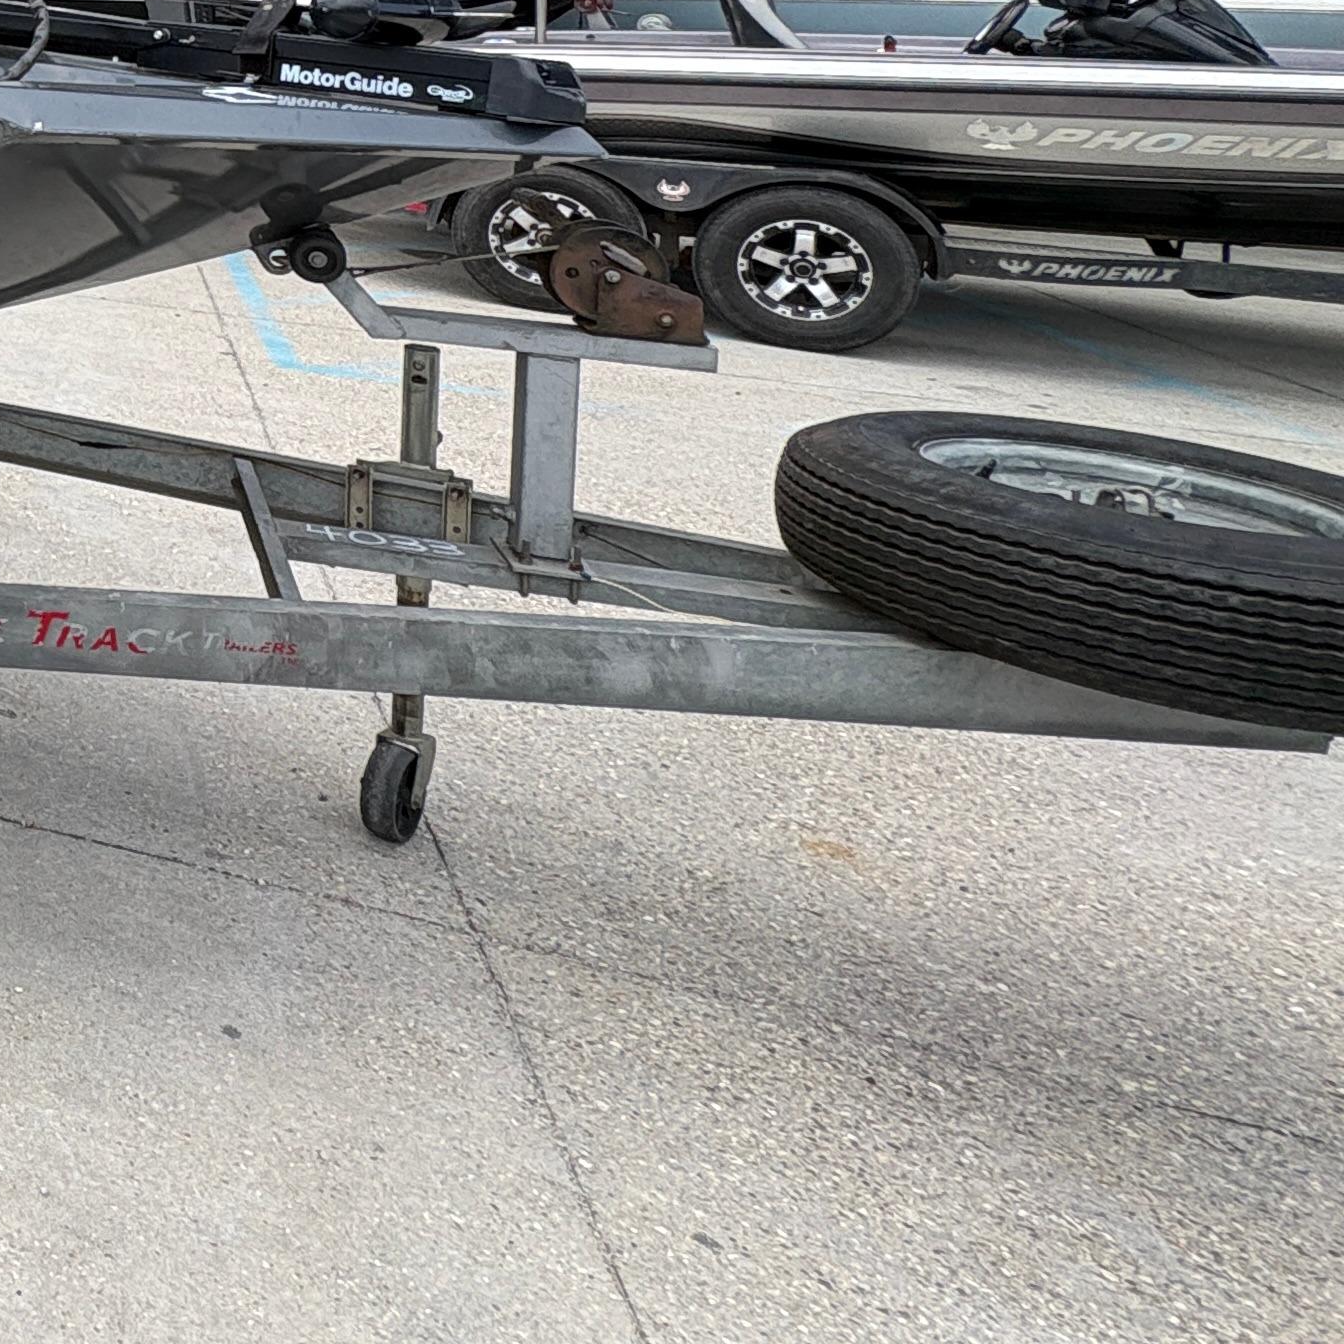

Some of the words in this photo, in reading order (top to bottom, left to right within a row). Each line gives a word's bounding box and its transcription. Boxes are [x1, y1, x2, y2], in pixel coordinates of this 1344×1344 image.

[279, 63, 414, 97] MotorGuide
[1035, 126, 1344, 161] PHOENIX
[1032, 262, 1182, 283] PHOENIX
[306, 524, 466, 556] 4033
[26, 610, 193, 655] TRACK
